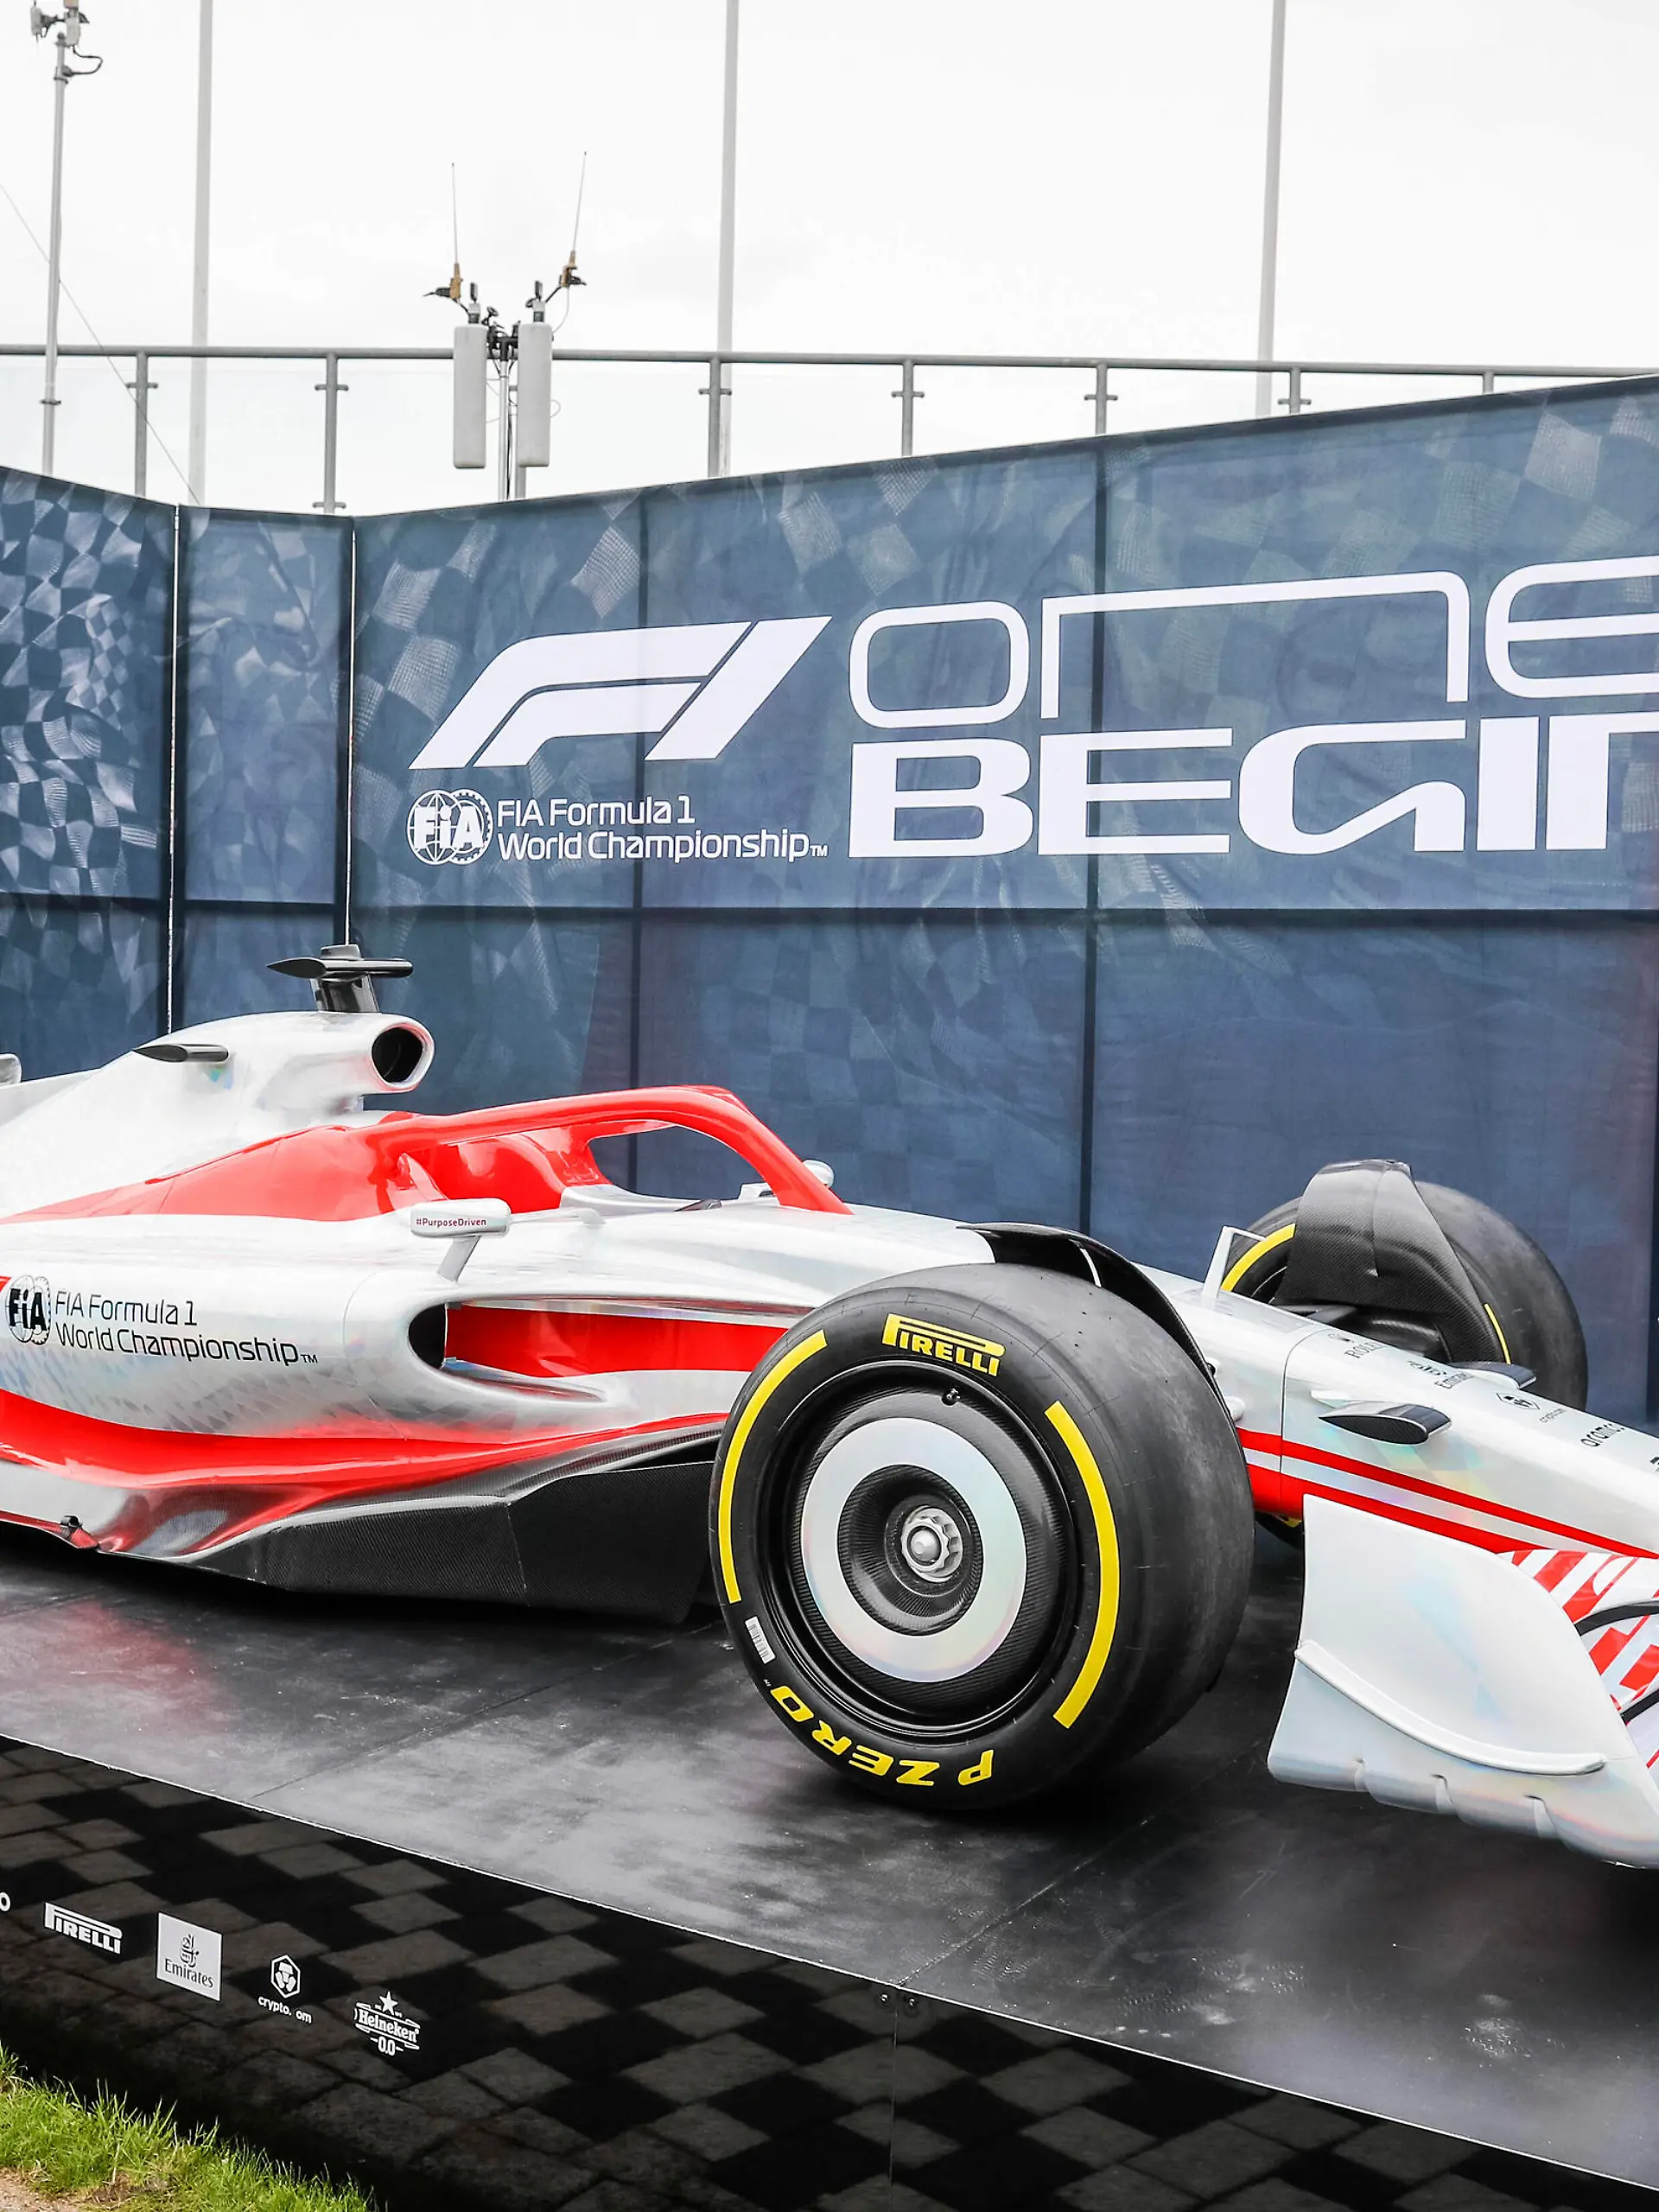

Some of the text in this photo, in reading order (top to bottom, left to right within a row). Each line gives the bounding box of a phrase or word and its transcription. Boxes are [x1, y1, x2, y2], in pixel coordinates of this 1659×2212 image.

[498, 795, 695, 827] FIA Formula 1
[499, 830, 582, 860] World
[416, 1217, 486, 1228] #PurposeDriven
[55, 1290, 197, 1325] FIA Formula 1
[56, 1324, 114, 1352] World
[882, 1313, 1006, 1376] PIRELLI
[771, 1686, 994, 1786] P ZERO
[45, 1902, 123, 1955] PIRELLI
[164, 1958, 214, 1989] Emirates
